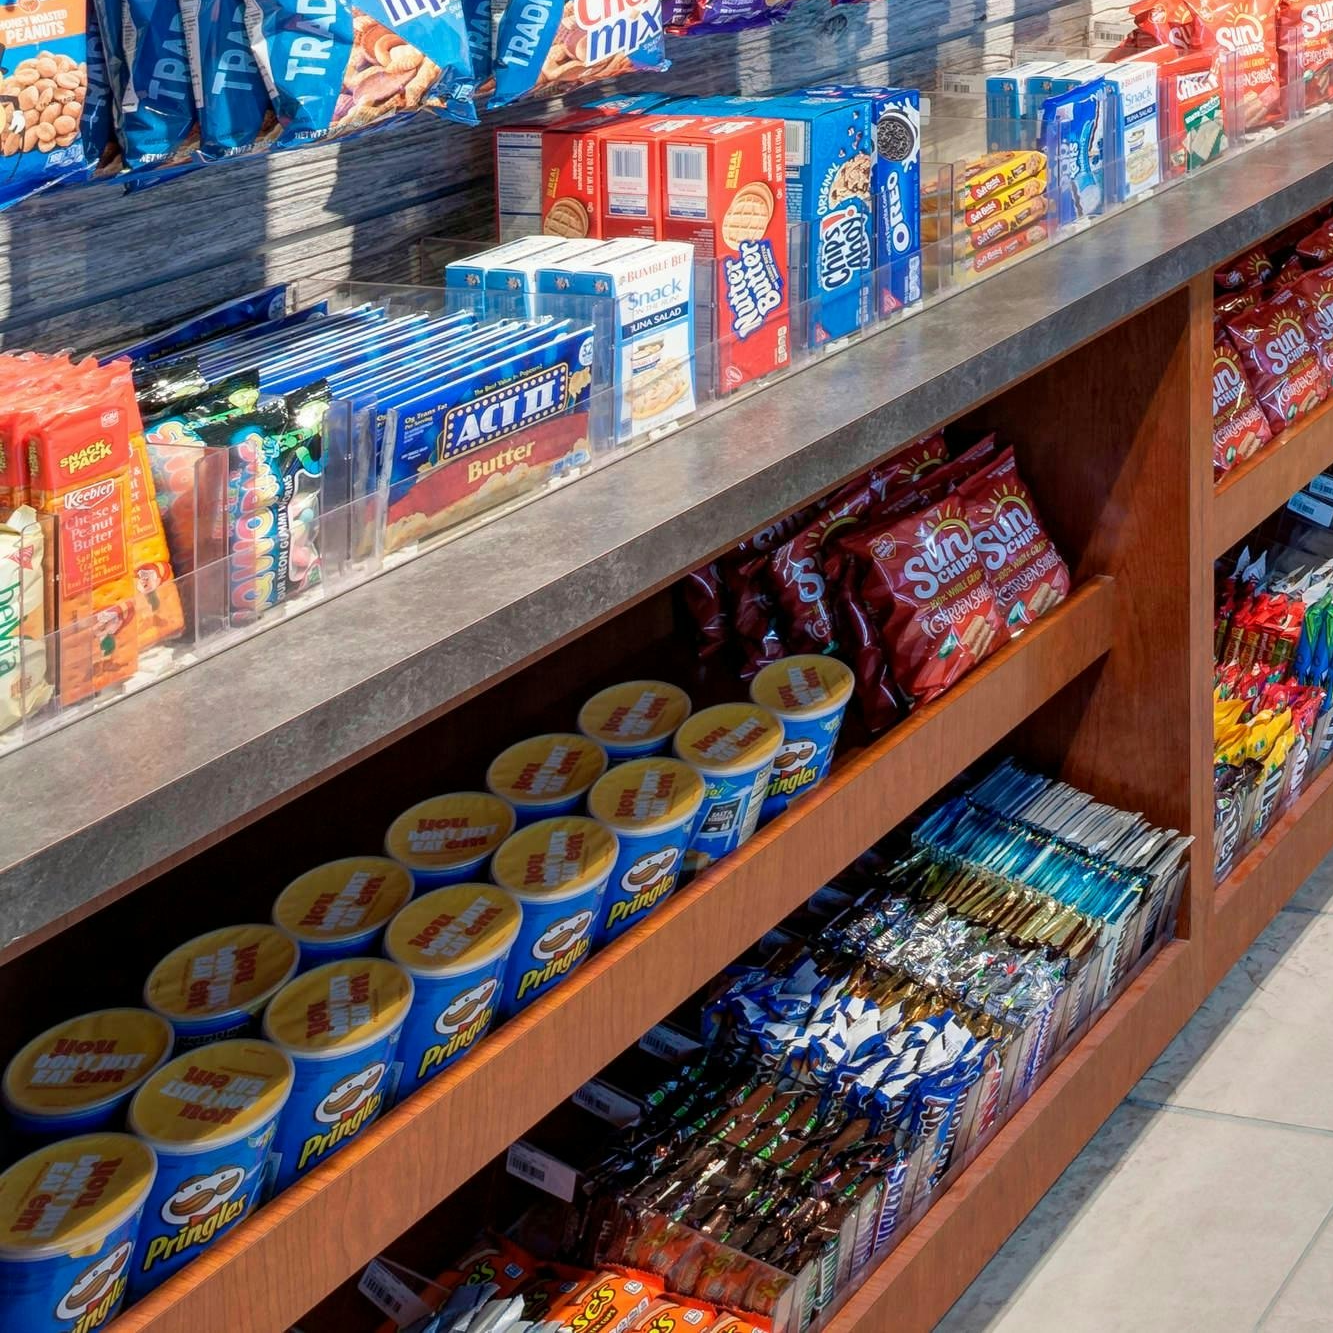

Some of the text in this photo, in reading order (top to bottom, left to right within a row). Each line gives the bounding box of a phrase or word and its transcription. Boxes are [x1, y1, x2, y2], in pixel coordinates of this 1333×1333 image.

[5, 20, 66, 44] PEANUTS
[589, 9, 662, 58] mix
[1216, 24, 1264, 52] Sun
[817, 163, 841, 215] ORIGINAL
[887, 171, 910, 252] OREO
[628, 257, 669, 283] BUMBLE
[741, 241, 782, 316] Butter
[822, 227, 851, 289] Chips
[628, 278, 682, 311] Snack
[654, 307, 682, 324] SALAD
[727, 259, 761, 340] Nutter
[456, 380, 556, 447] ACT II
[60, 439, 107, 469] SNACK
[69, 447, 113, 474] PACK
[467, 441, 536, 484] Butter
[65, 480, 115, 509] Keebler
[71, 518, 115, 541] Peanut
[72, 529, 115, 552] Butter
[1006, 524, 1040, 555] CHIPS
[905, 529, 974, 601] Sun
[937, 549, 978, 583] CHIPS
[606, 872, 676, 930] Pringles
[517, 937, 591, 1001] Pringles
[299, 1083, 384, 1169] Pringles
[144, 1193, 248, 1271] Pringles
